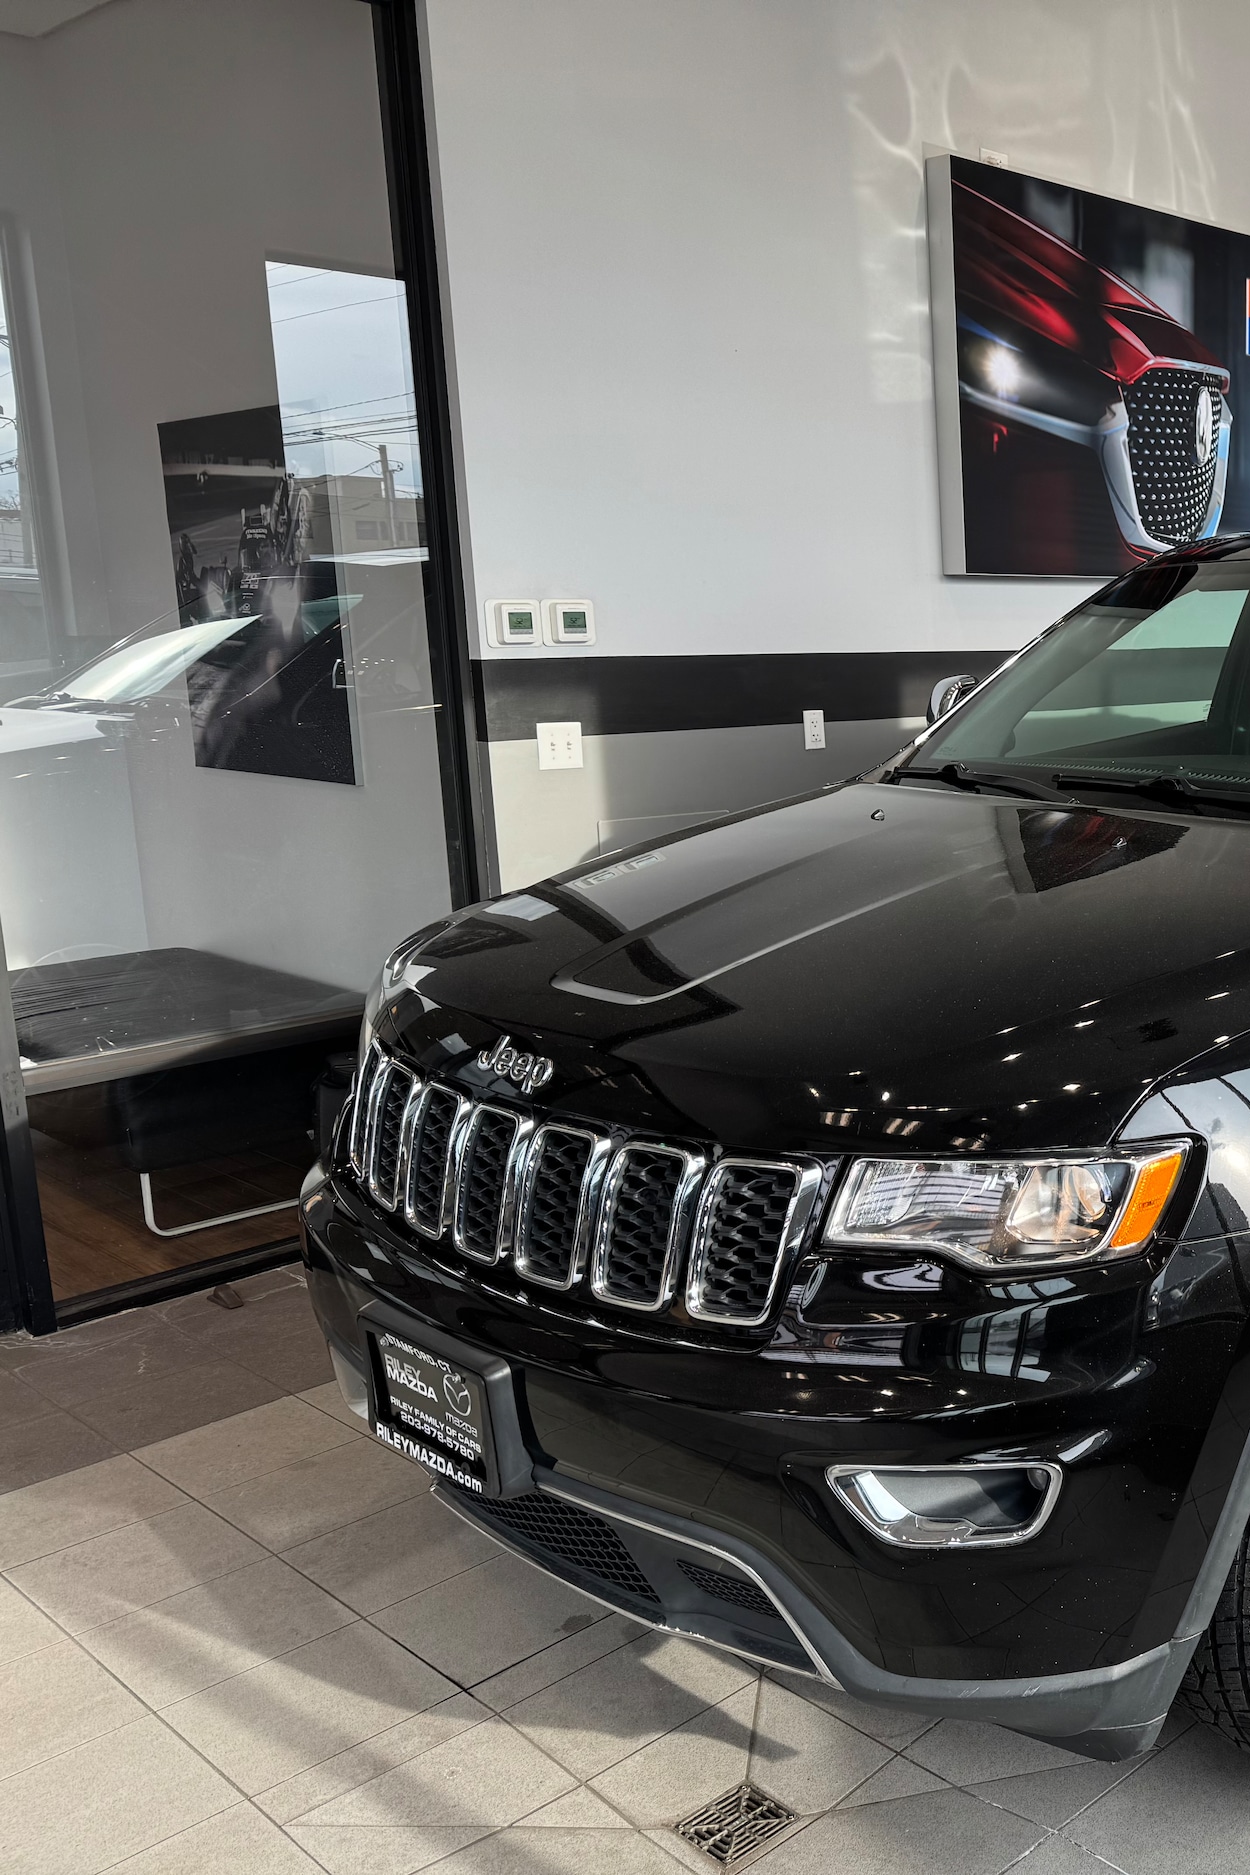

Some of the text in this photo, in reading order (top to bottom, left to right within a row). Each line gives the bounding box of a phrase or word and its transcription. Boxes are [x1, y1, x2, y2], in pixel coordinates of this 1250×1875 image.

[477, 1034, 554, 1094] Jeep
[384, 1353, 421, 1380] RILEY
[386, 1365, 439, 1402] MAZDA
[390, 1395, 481, 1453] RILEY FAMILY OF CARS
[376, 1421, 482, 1494] RILEYMAZDA.com
